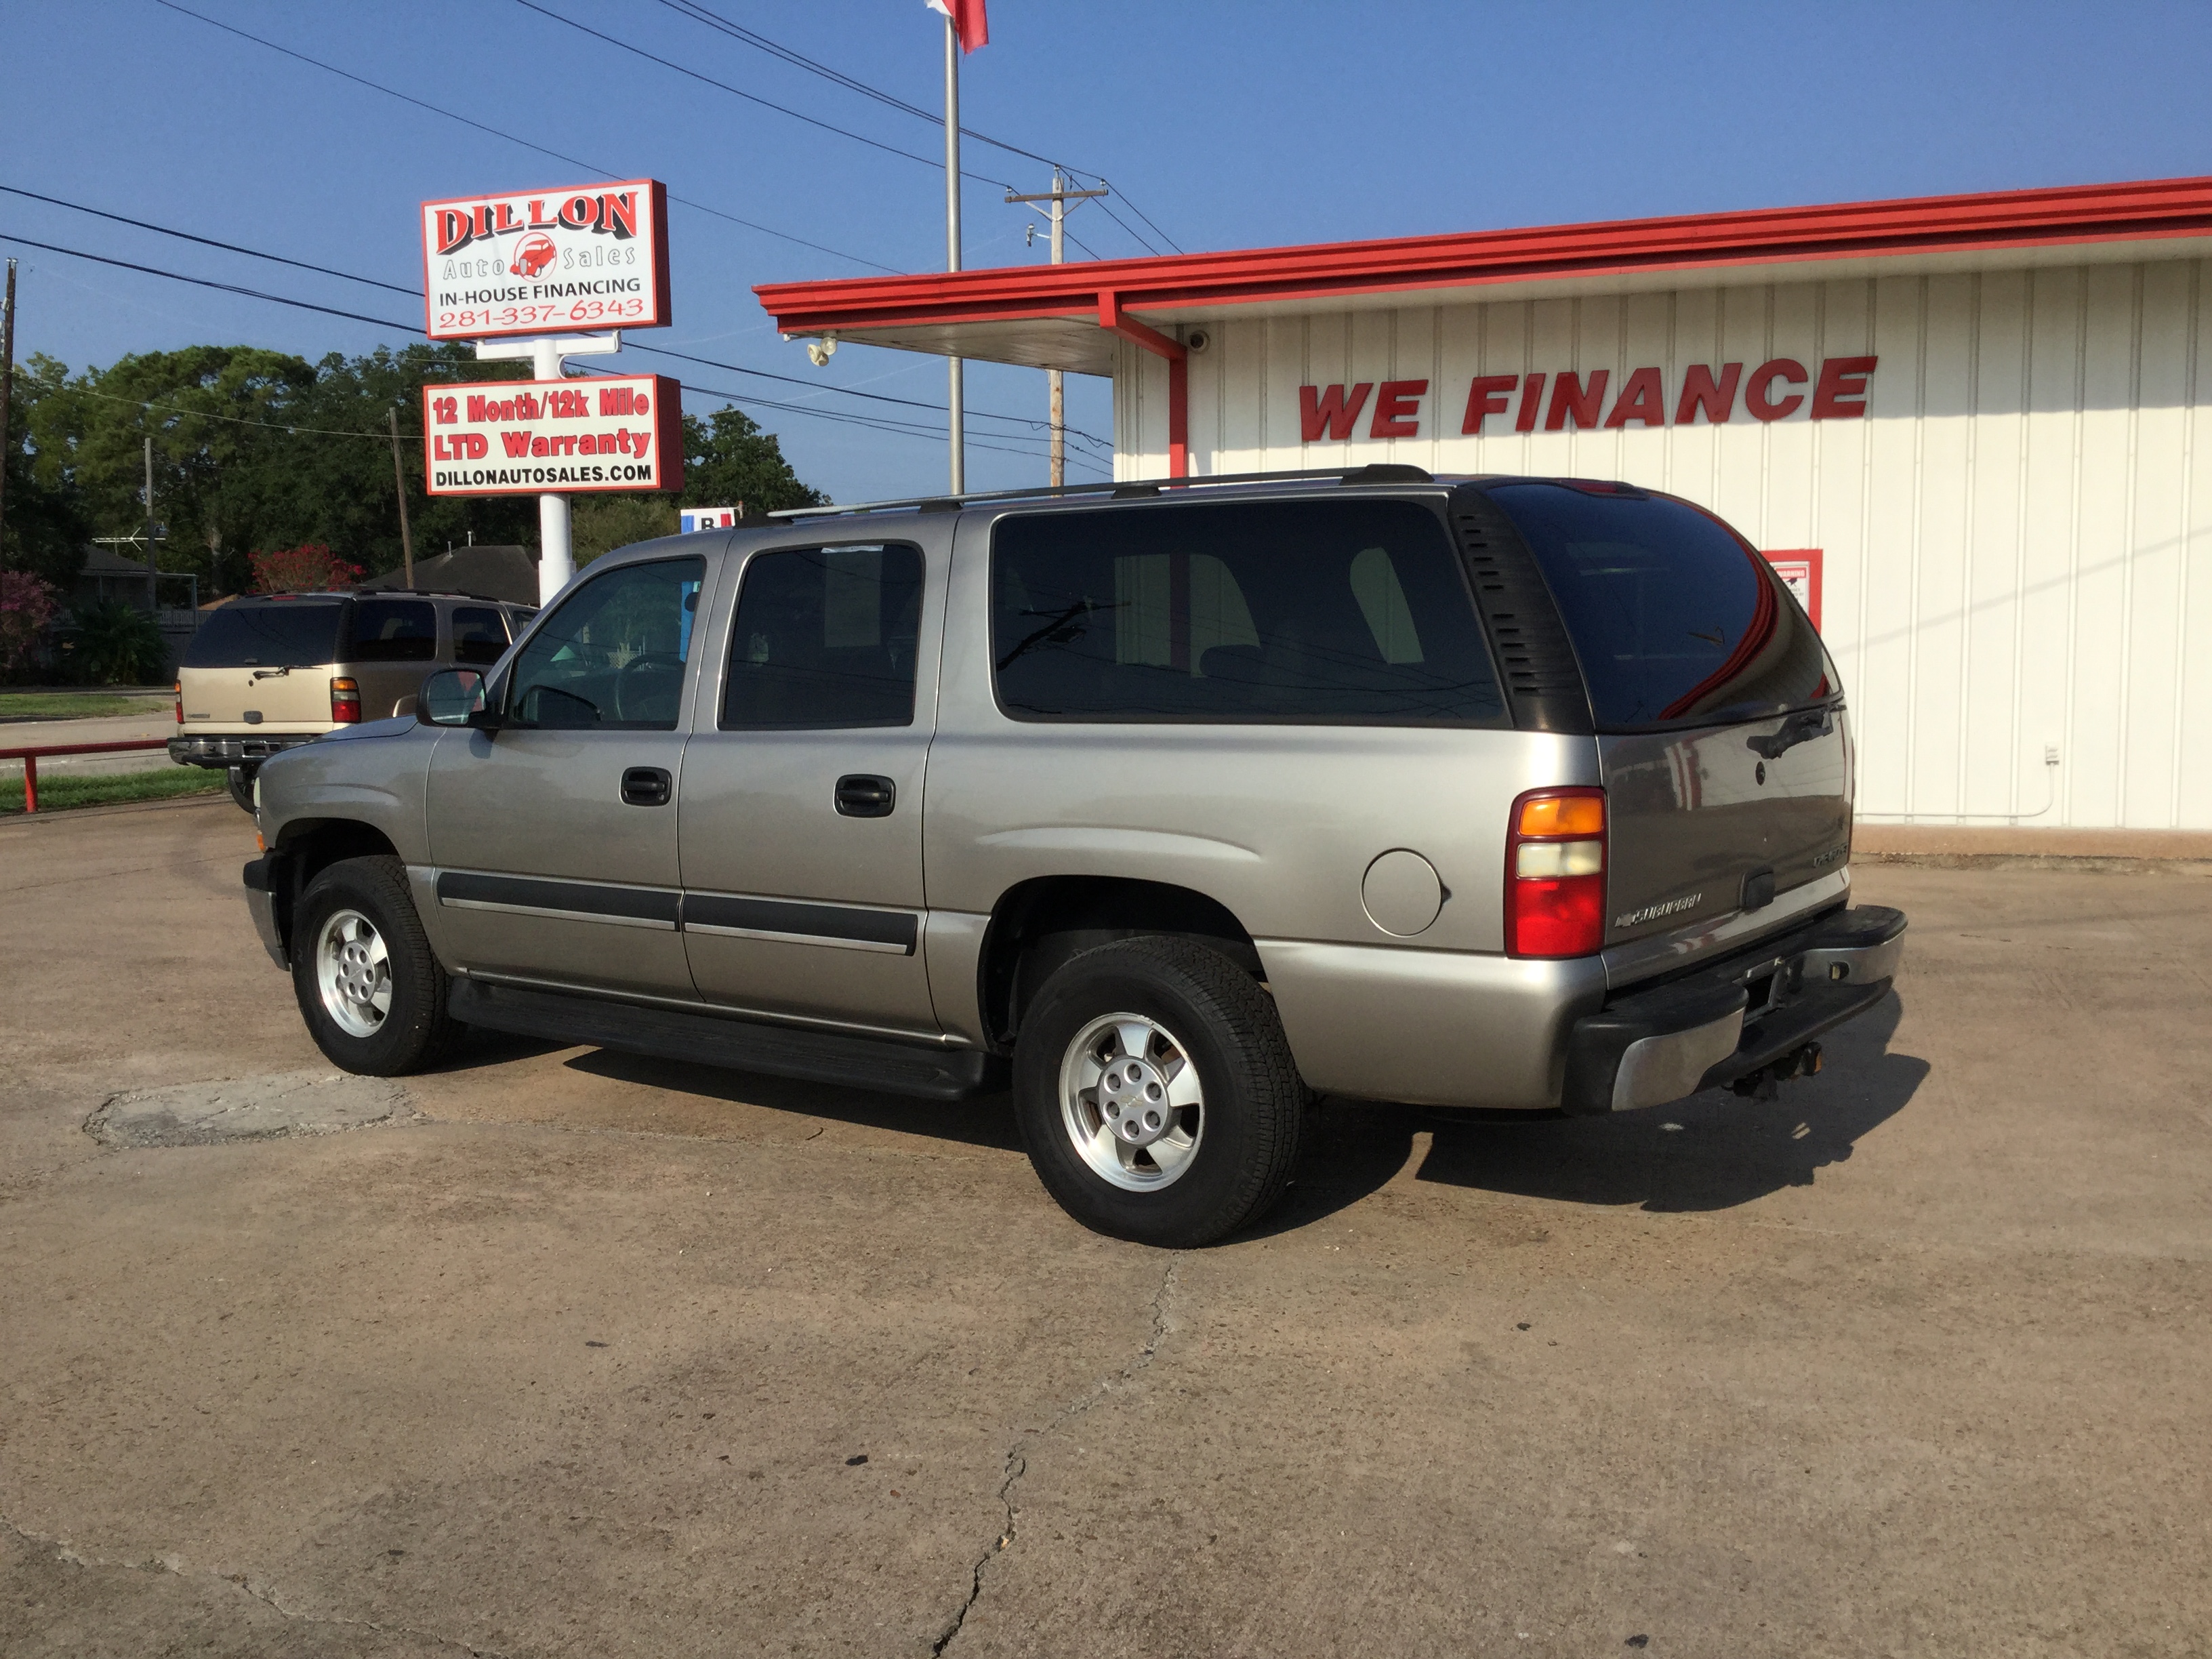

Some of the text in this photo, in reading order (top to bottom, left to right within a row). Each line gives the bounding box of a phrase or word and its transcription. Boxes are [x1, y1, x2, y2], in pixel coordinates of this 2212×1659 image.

[434, 191, 638, 255] DILLON
[443, 245, 636, 280] Auto Sales
[440, 278, 640, 306] IN-HOUSE FINANCING
[439, 299, 643, 329] 281-337-6343
[432, 387, 649, 424] 12 Month/12k Mile
[1299, 356, 1879, 441] WE FINANCE
[434, 428, 651, 461] LTD Warranty
[436, 465, 651, 487] DILLONAUTOSALES.COM
